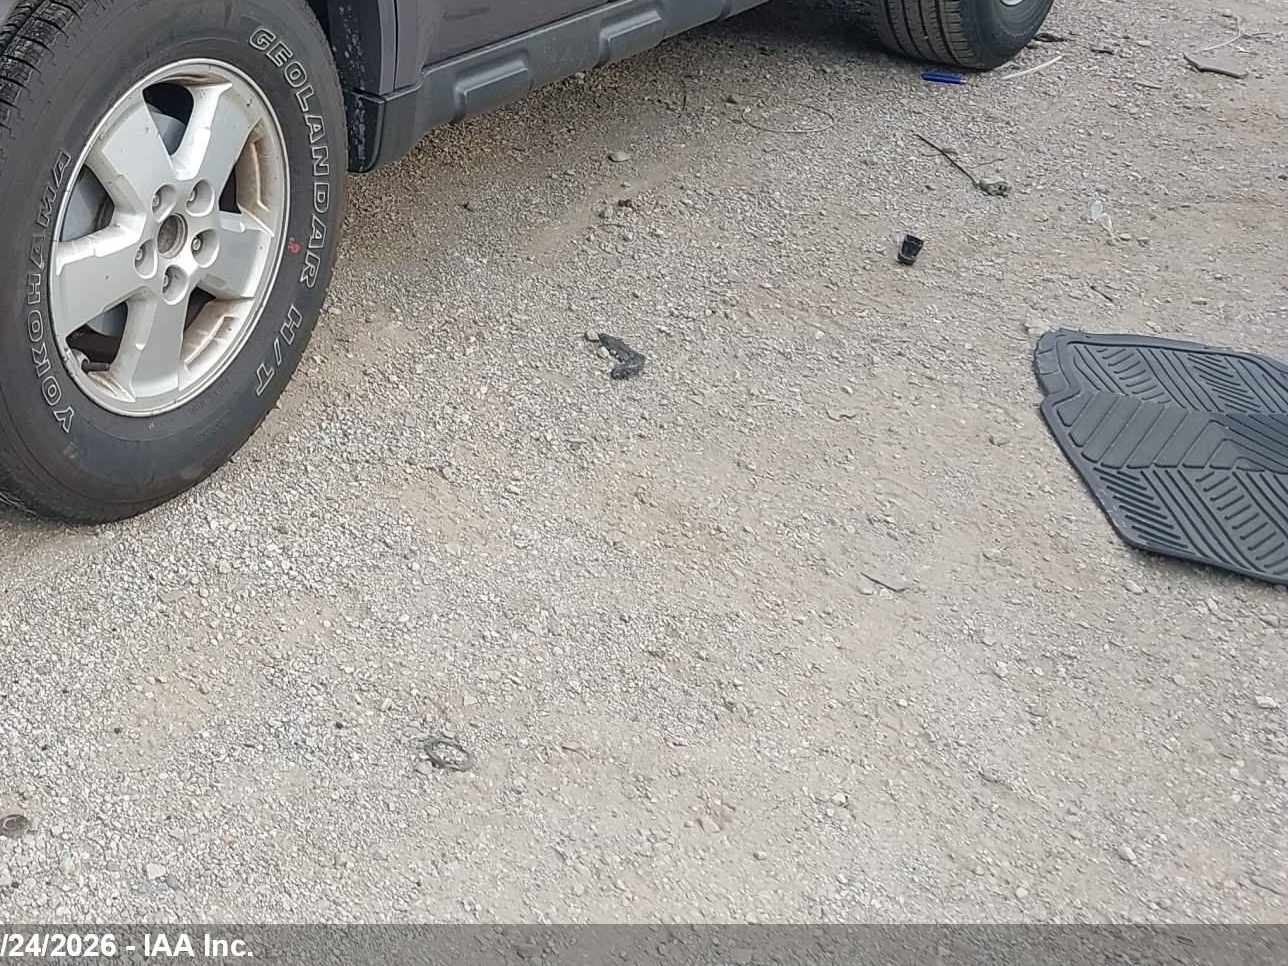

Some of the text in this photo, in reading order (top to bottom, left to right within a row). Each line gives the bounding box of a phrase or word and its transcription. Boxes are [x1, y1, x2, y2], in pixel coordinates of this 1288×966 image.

[24, 151, 74, 434] YOKOHAMA
[249, 25, 331, 398] GEOLANDAR H/T
